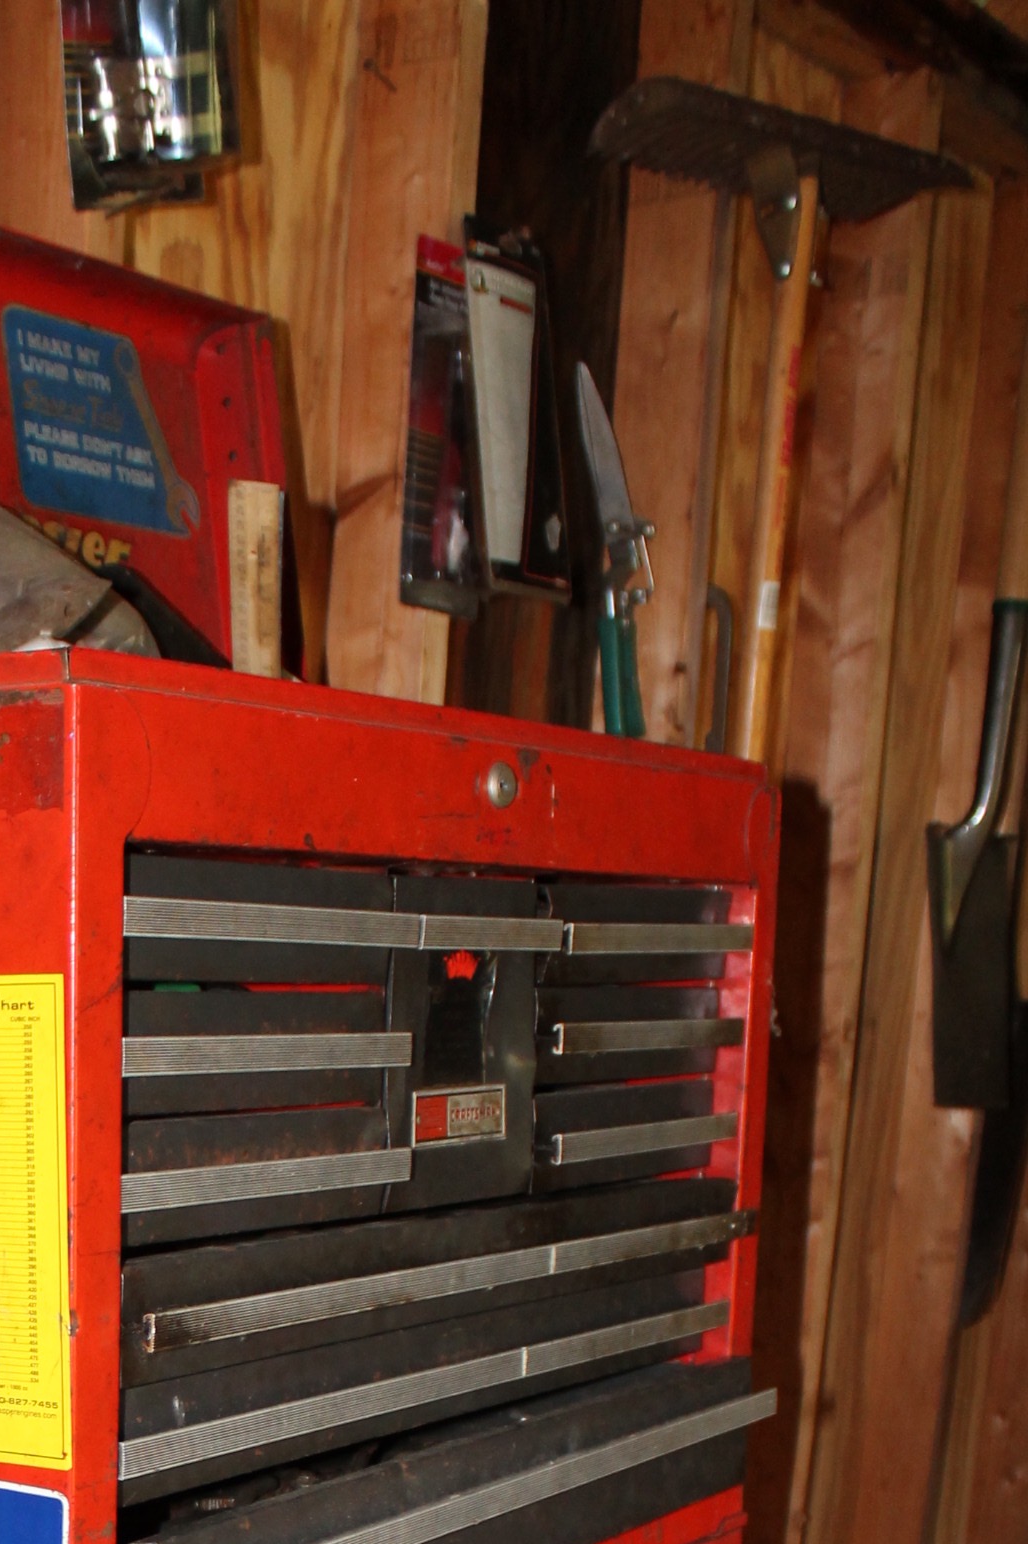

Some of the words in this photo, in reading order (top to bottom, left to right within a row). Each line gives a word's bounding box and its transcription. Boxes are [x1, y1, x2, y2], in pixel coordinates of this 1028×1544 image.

[17, 328, 24, 345] I
[27, 330, 73, 359] MAKE
[77, 345, 101, 366] MY
[20, 353, 69, 382] LIVING
[74, 368, 111, 393] WITH
[24, 420, 79, 449] PLEASE
[82, 434, 123, 459] DON'T
[126, 446, 153, 466] ASK
[27, 445, 48, 465] TO
[54, 450, 111, 479] BORROW
[116, 465, 156, 489] THEM
